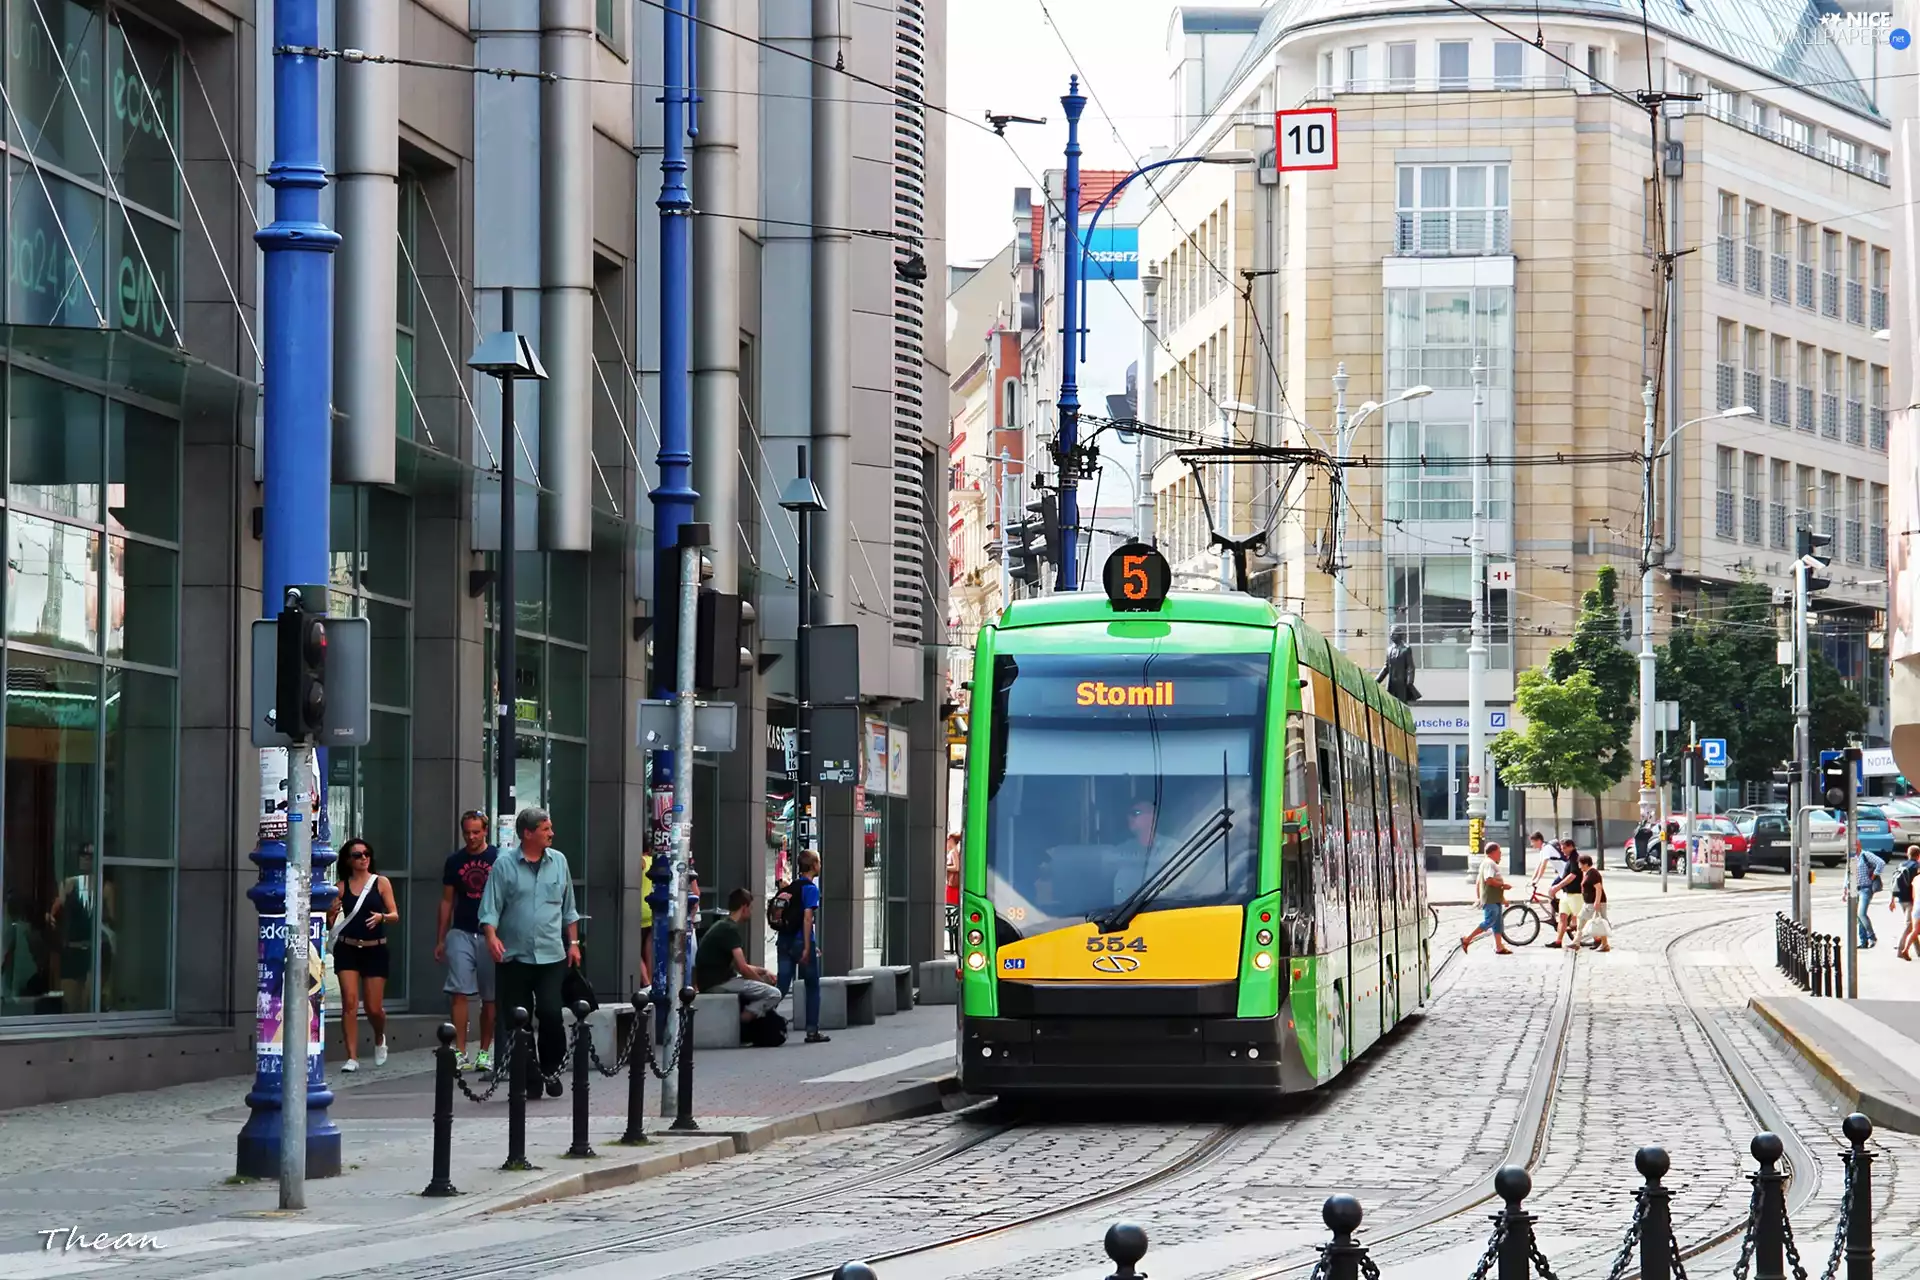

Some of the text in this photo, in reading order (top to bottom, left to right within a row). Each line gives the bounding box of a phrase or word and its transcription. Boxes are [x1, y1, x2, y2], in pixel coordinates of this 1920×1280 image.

[113, 67, 166, 140] ecco
[1288, 124, 1325, 155] 10
[1122, 554, 1149, 600] 5
[1076, 681, 1175, 706] Stomil
[1704, 742, 1720, 759] P
[1867, 756, 1895, 767] NOTA
[1086, 936, 1147, 952] 554
